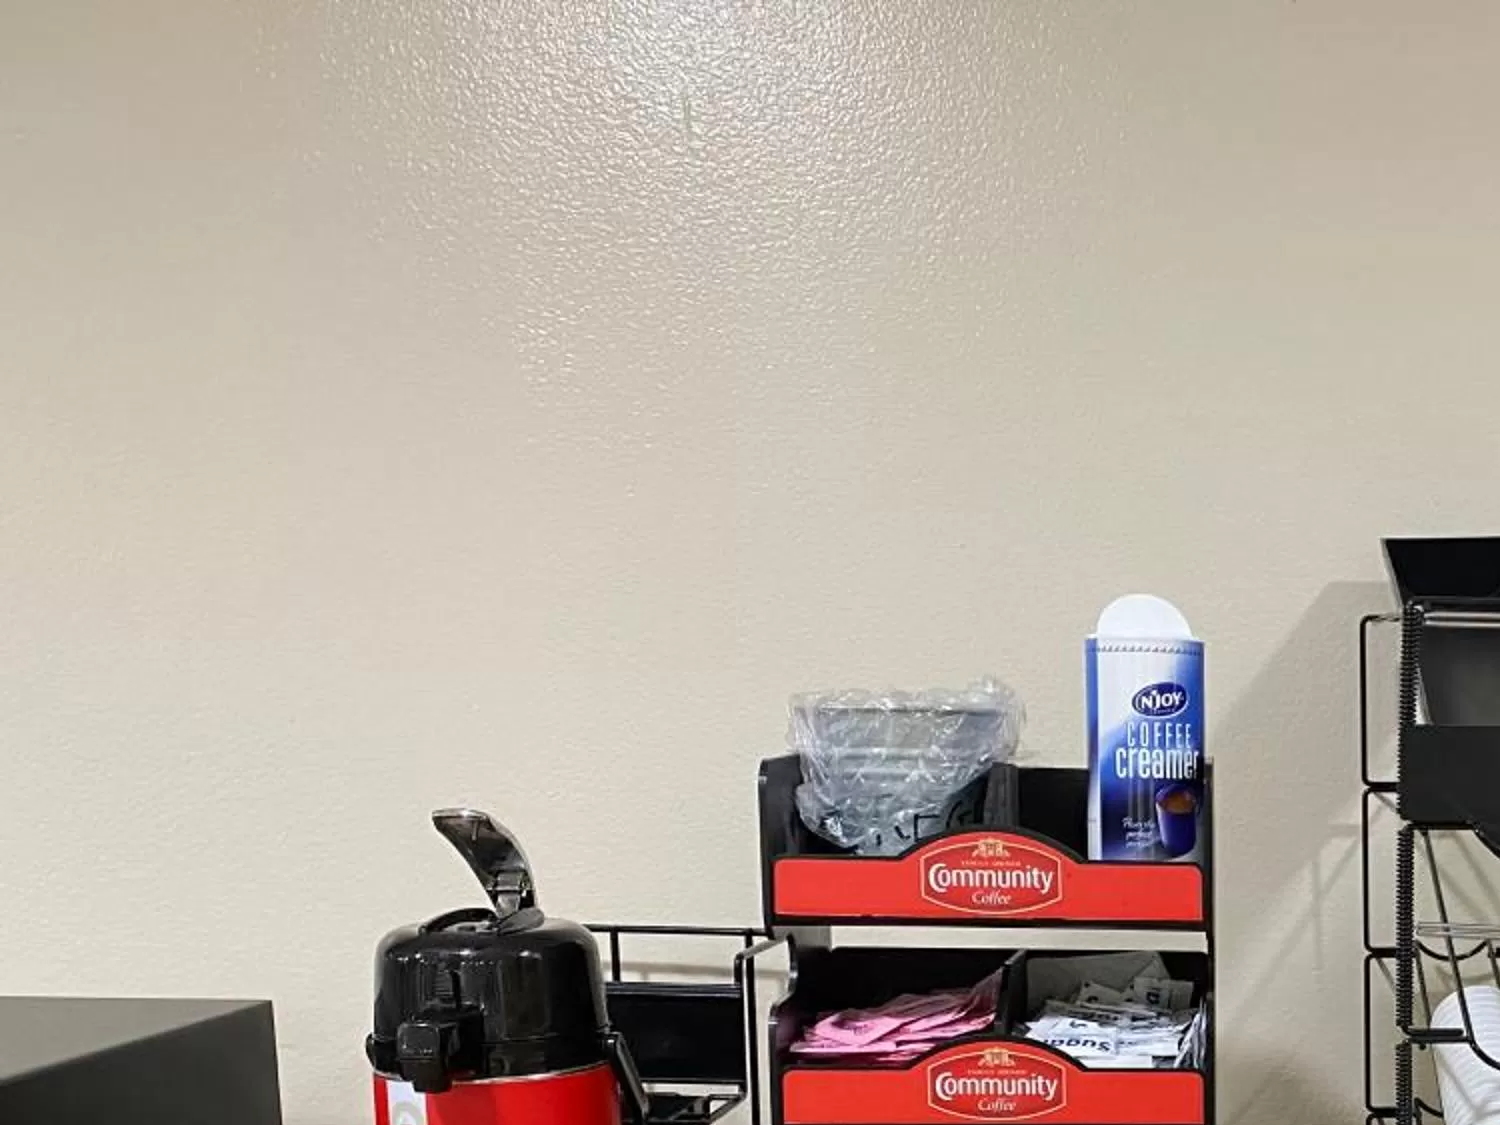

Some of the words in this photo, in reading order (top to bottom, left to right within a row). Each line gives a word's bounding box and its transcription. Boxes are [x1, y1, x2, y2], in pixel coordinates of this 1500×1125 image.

[1127, 721, 1191, 749] COFFEE
[1115, 747, 1199, 779] creamer
[928, 863, 1053, 895] Community
[971, 890, 1012, 905] Coffee
[935, 1072, 1058, 1101] Community
[978, 1098, 1017, 1112] Coffee
